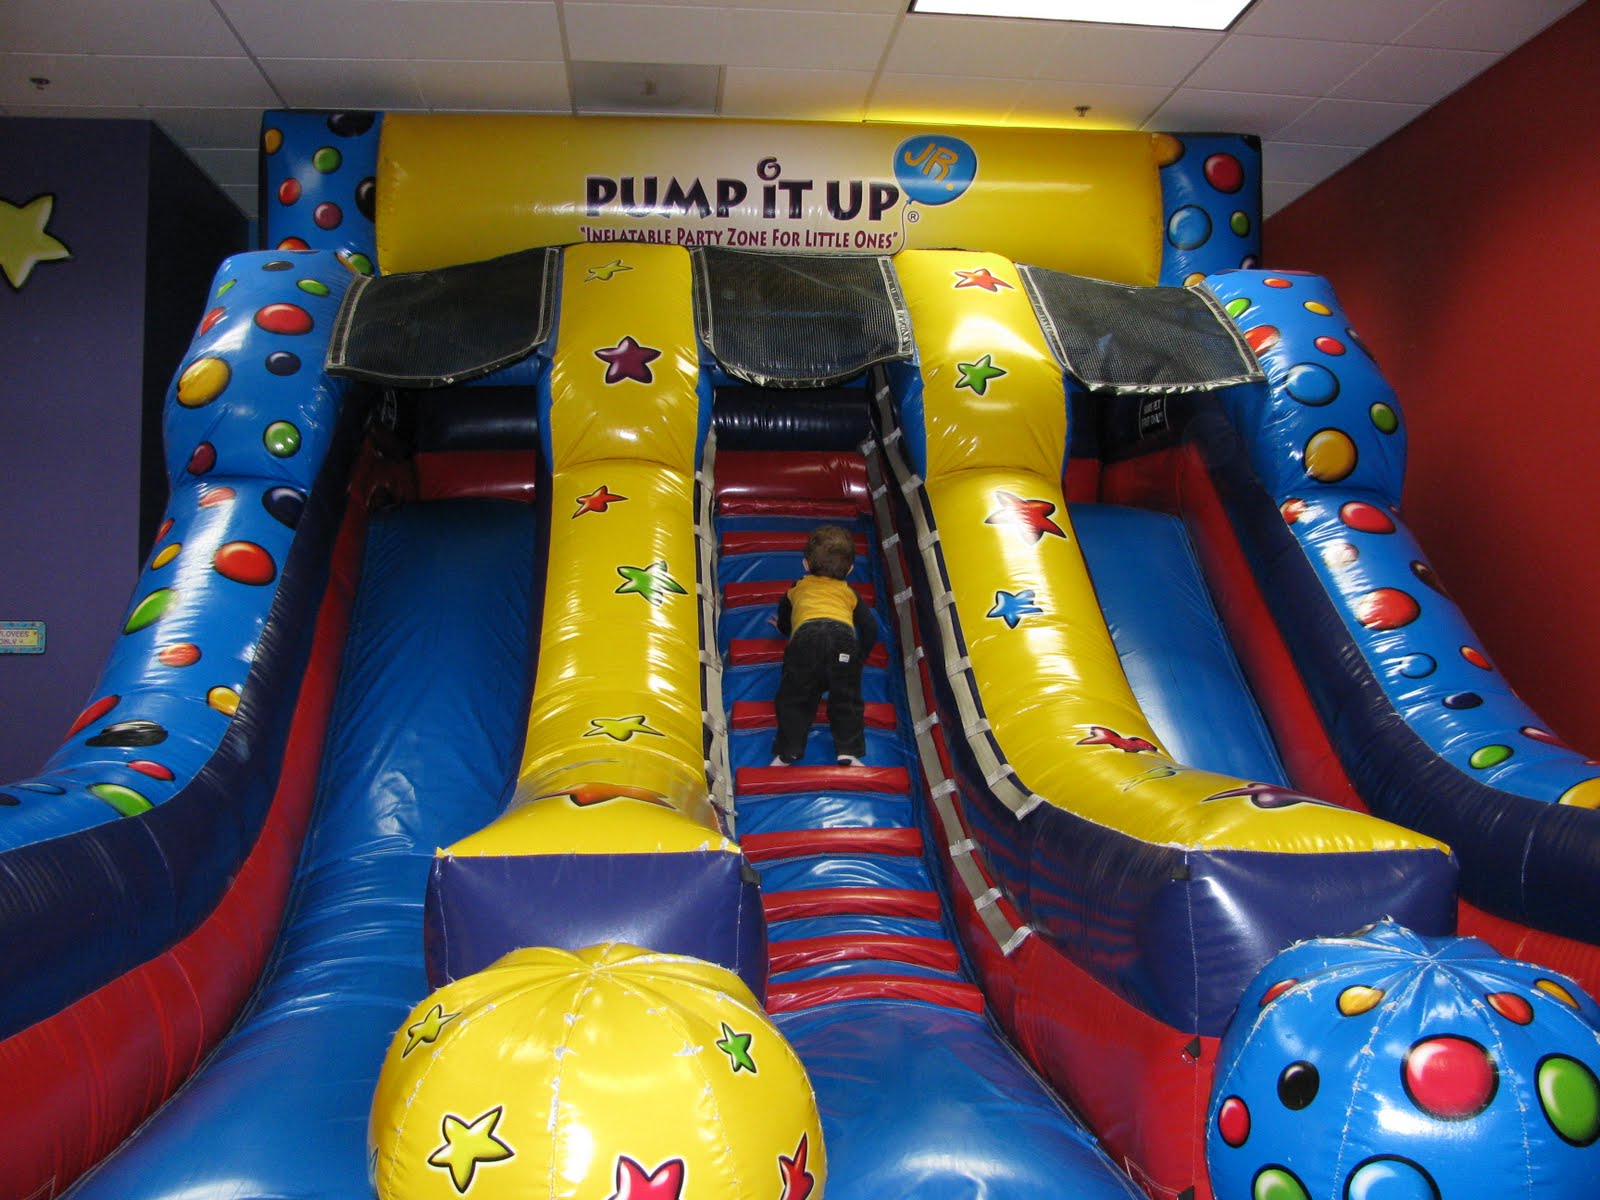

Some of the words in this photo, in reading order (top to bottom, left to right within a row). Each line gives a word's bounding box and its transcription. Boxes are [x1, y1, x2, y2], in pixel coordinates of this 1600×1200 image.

[904, 143, 959, 191] JR.
[586, 176, 748, 219] PUMP
[826, 180, 900, 221] UP
[677, 227, 723, 246] PARTY
[727, 228, 767, 246] ZONE
[772, 229, 800, 247] FOR
[805, 230, 850, 248] LITTLE
